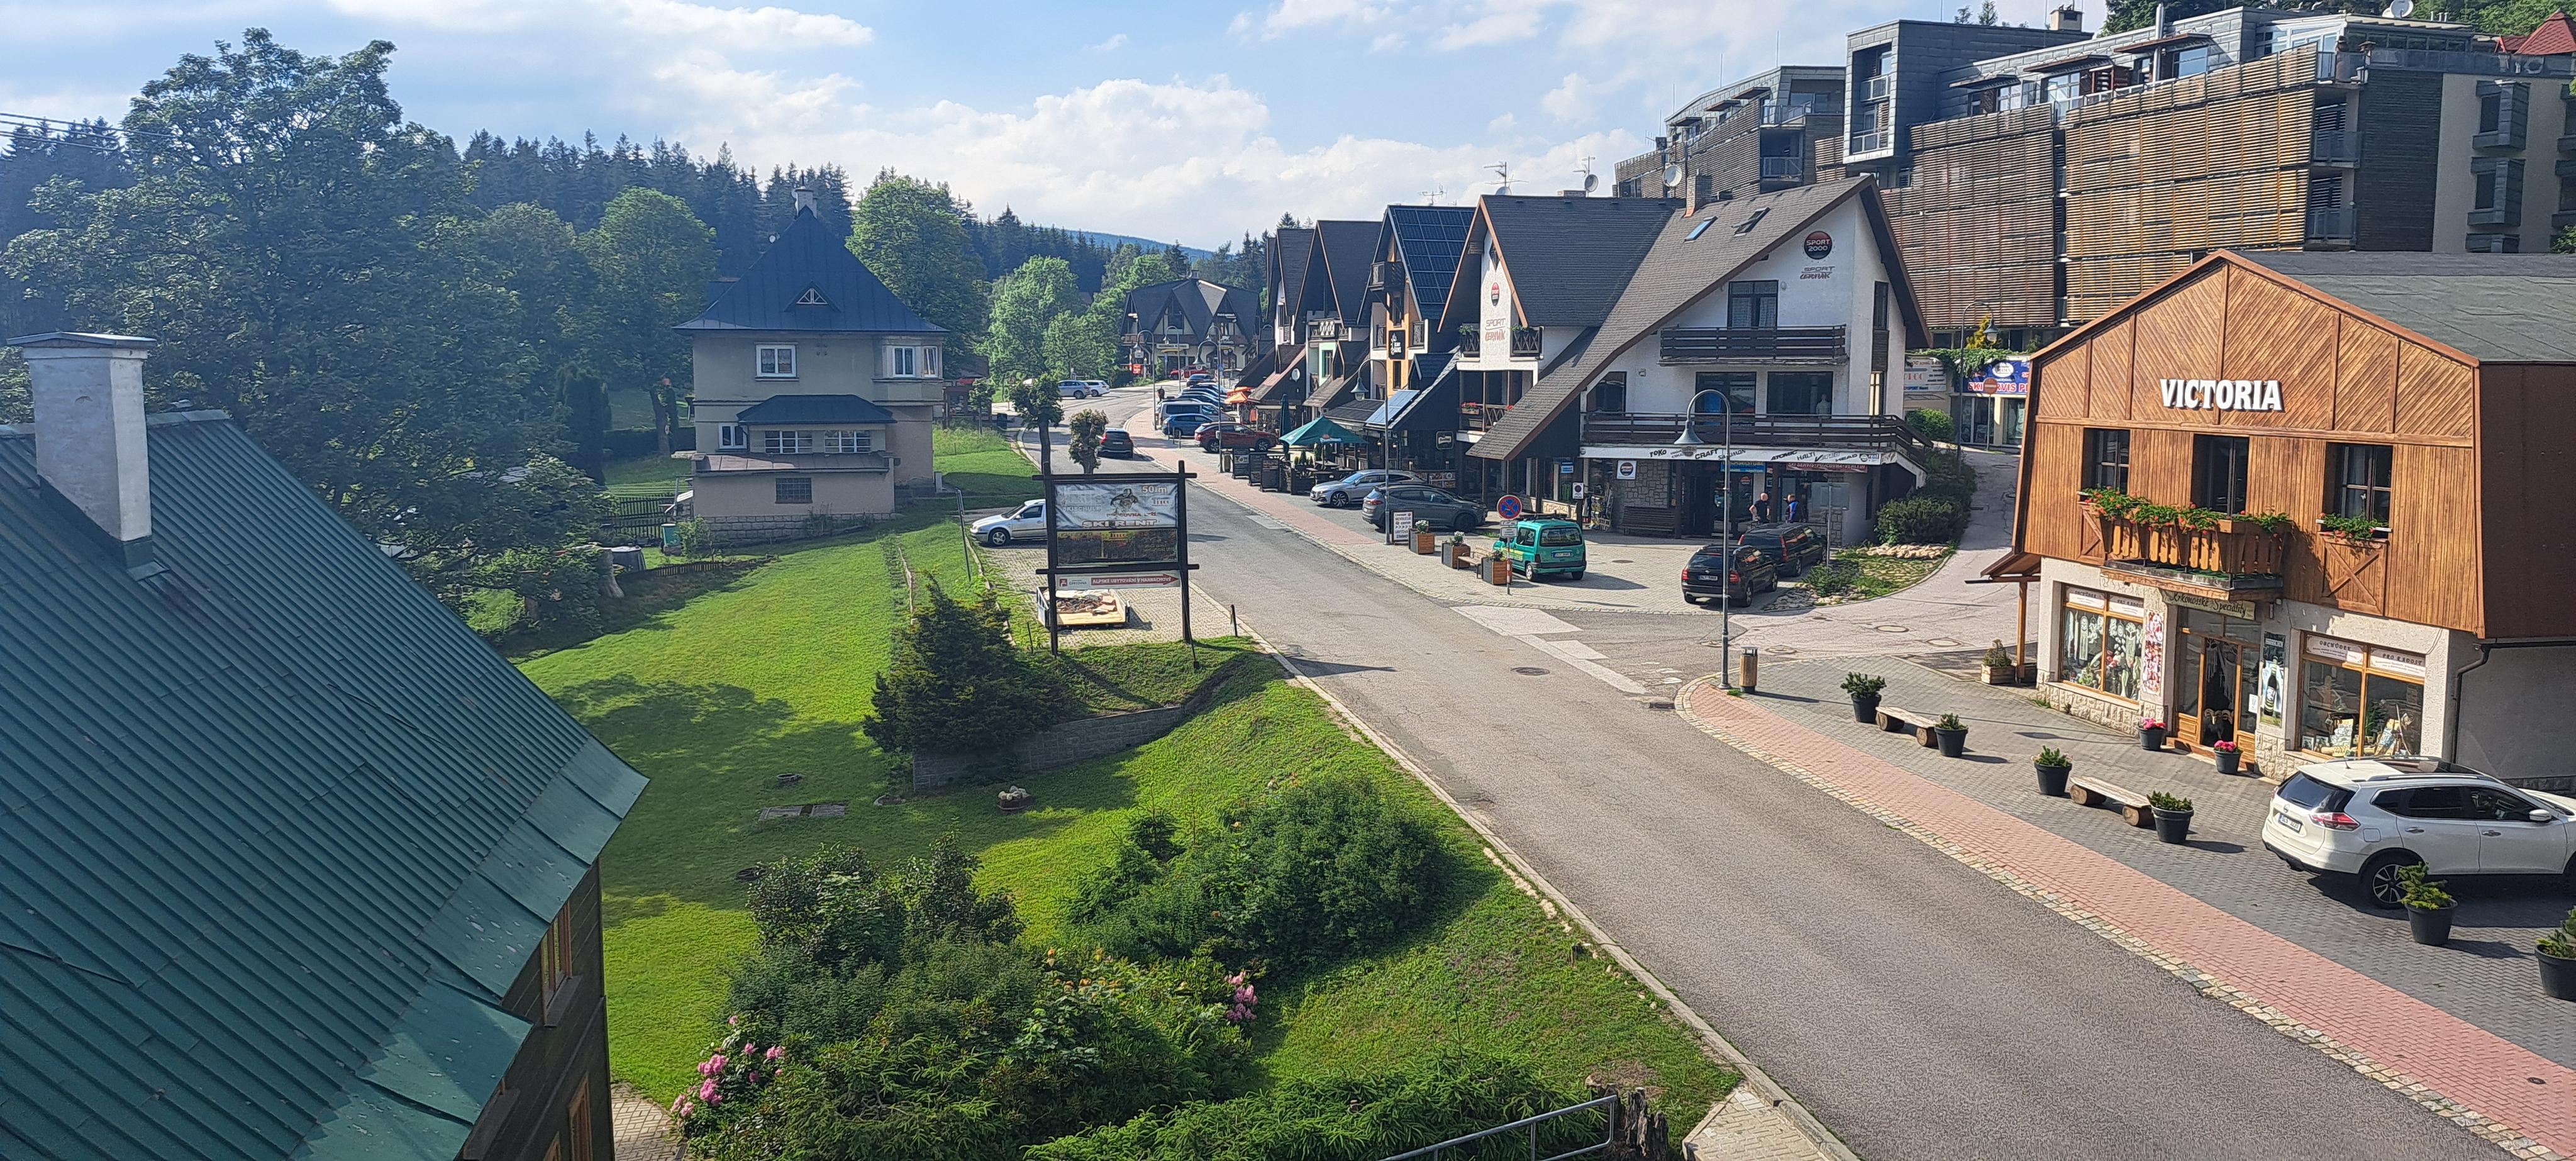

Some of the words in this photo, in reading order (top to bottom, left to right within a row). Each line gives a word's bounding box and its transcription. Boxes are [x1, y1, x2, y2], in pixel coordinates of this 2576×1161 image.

[1485, 318, 1506, 326] SPORT
[1968, 382, 1984, 391] SKI
[2159, 378, 2284, 411] VICTORIA
[1650, 449, 1667, 458] TOKO
[1694, 448, 1719, 460] CRAFT
[1770, 449, 1798, 461] ATOMIC
[1797, 452, 1815, 461] HALTI
[1836, 453, 1858, 462] HEAD
[1141, 486, 1154, 494] 50
[1082, 519, 1111, 528] SKI
[1114, 519, 1158, 527] RENT
[2397, 656, 2423, 666] RADOST
